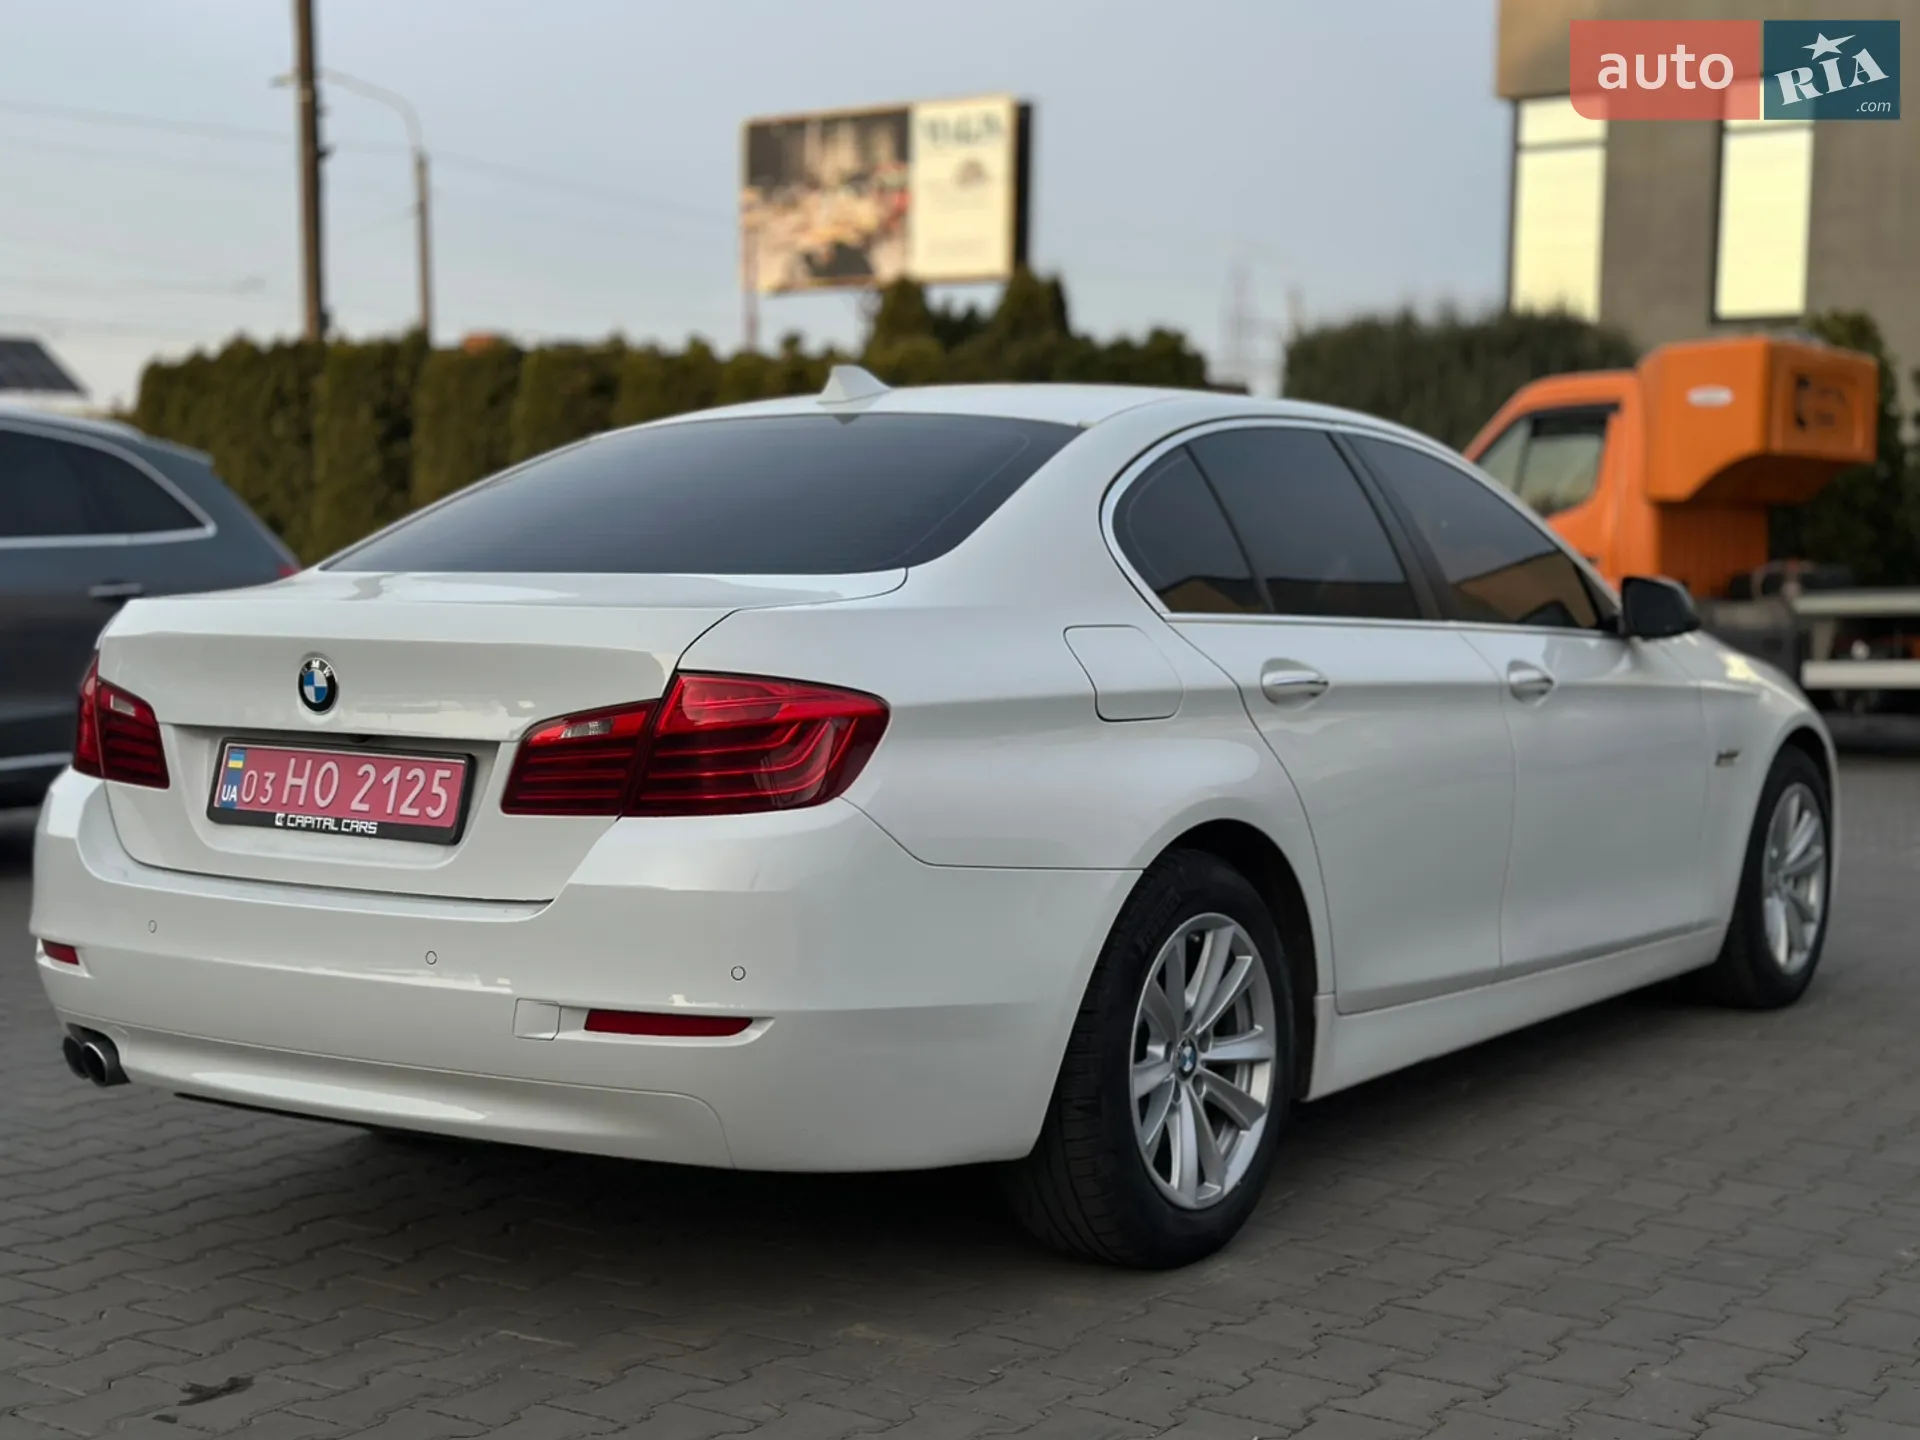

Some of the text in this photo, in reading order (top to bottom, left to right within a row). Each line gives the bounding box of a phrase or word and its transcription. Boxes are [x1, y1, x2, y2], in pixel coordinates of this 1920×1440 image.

[221, 784, 238, 802] UA
[241, 758, 451, 819] 03 HO 2125
[286, 814, 339, 831] CAPITAL
[341, 819, 378, 835] CARS
